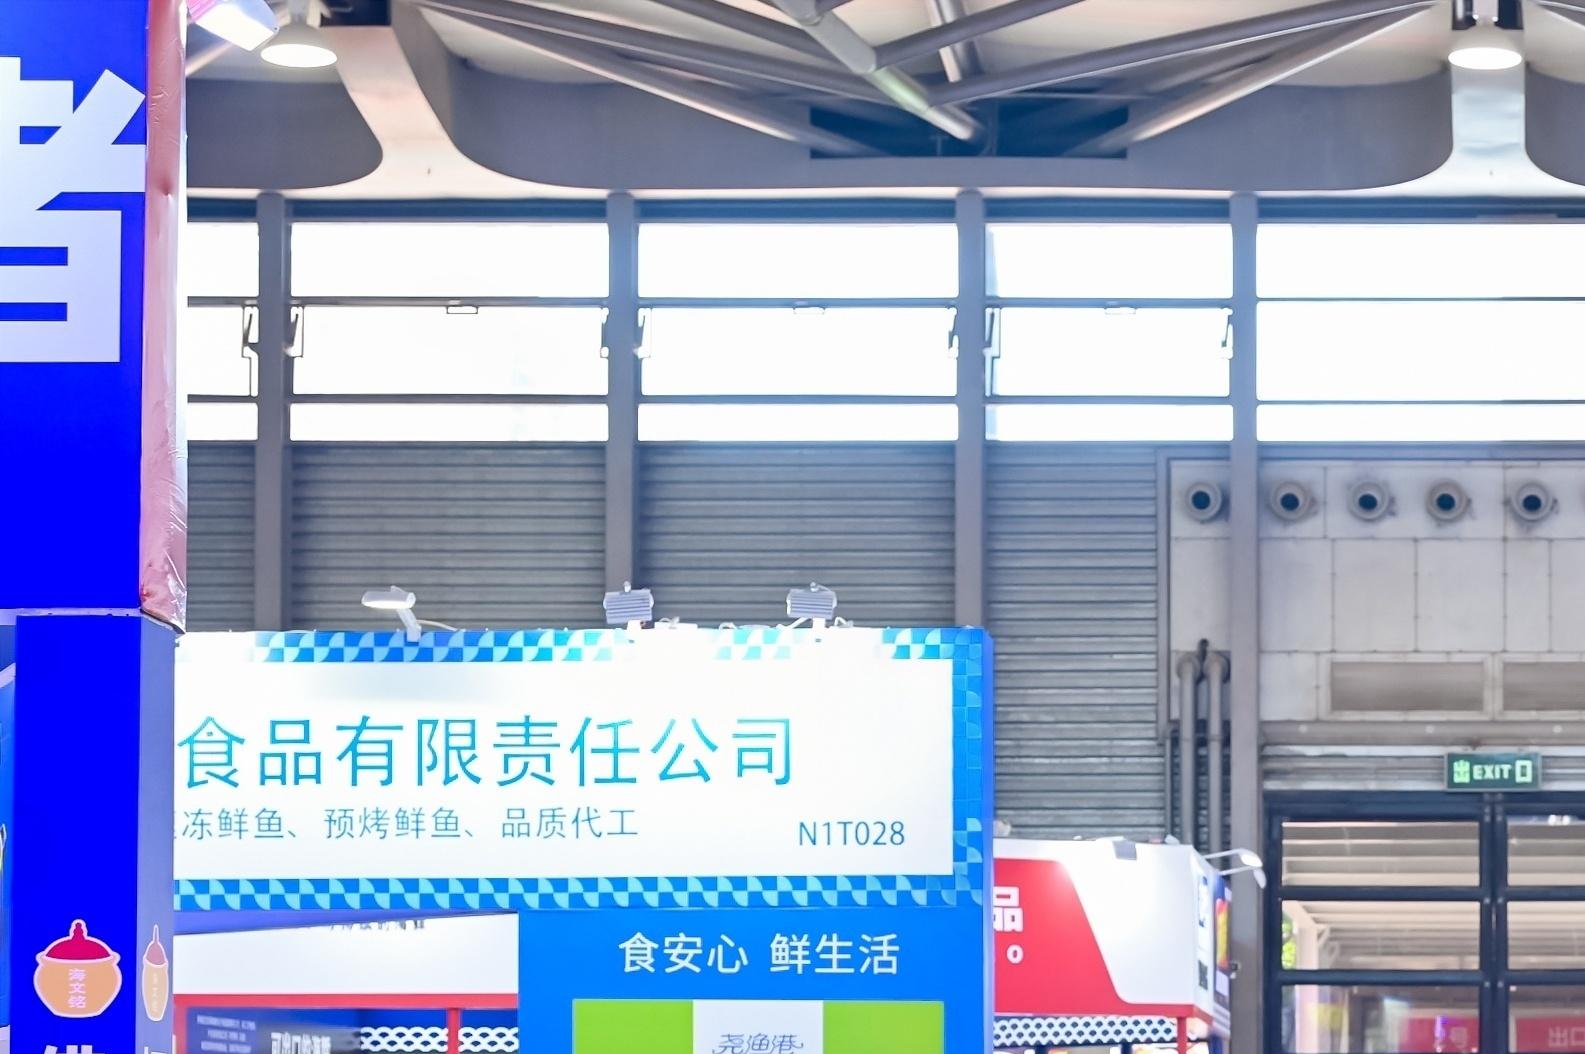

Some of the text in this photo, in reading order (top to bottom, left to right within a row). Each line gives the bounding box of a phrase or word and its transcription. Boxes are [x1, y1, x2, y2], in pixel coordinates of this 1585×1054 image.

[177, 714, 793, 787] 食品有限责任公司
[1472, 764, 1513, 780] EXIT
[174, 806, 639, 841] 冻鲜鱼、预烤鲜鱼、品质代工
[798, 821, 906, 847] N1T028
[618, 932, 900, 975] 食安心 鲜生活
